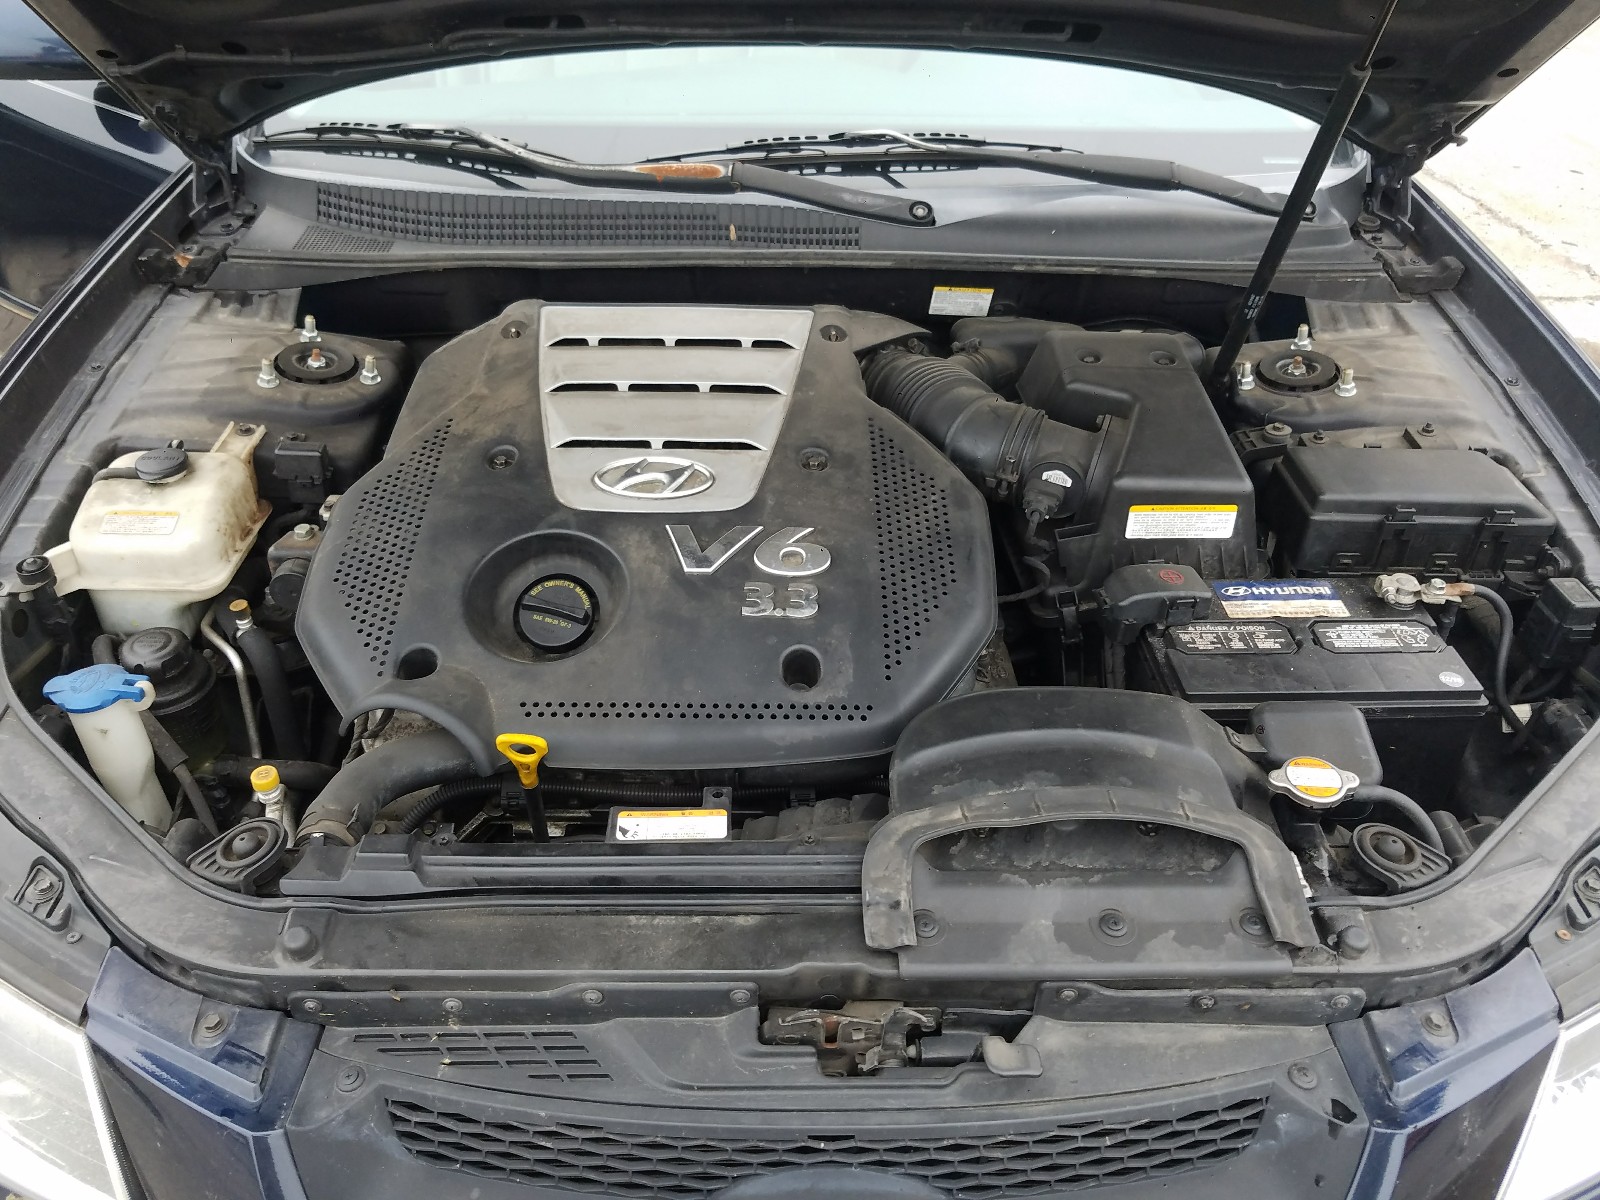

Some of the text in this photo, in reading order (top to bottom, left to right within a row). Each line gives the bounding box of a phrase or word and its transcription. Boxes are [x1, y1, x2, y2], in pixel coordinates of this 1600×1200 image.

[665, 524, 832, 577] V6
[530, 580, 591, 610] SEE OWNER'S MANUAL
[741, 581, 819, 618] 3.3
[1251, 586, 1332, 595] HYUNDAI
